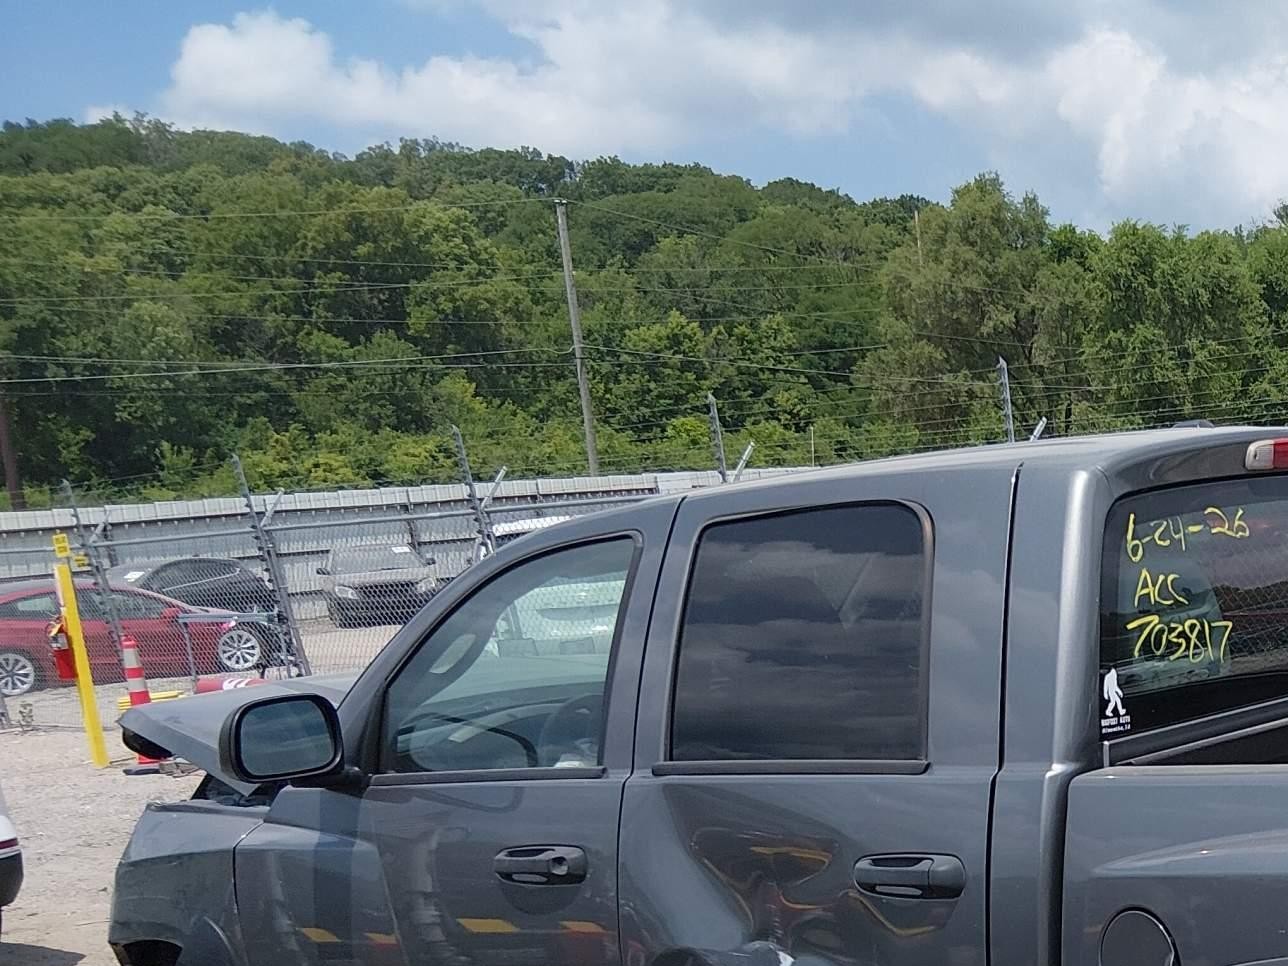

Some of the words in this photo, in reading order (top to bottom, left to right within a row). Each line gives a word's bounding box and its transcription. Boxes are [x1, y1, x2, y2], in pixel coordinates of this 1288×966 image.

[1126, 507, 1250, 563] 6-24-26
[1134, 567, 1190, 608] ACC
[1126, 614, 1233, 664] 703817
